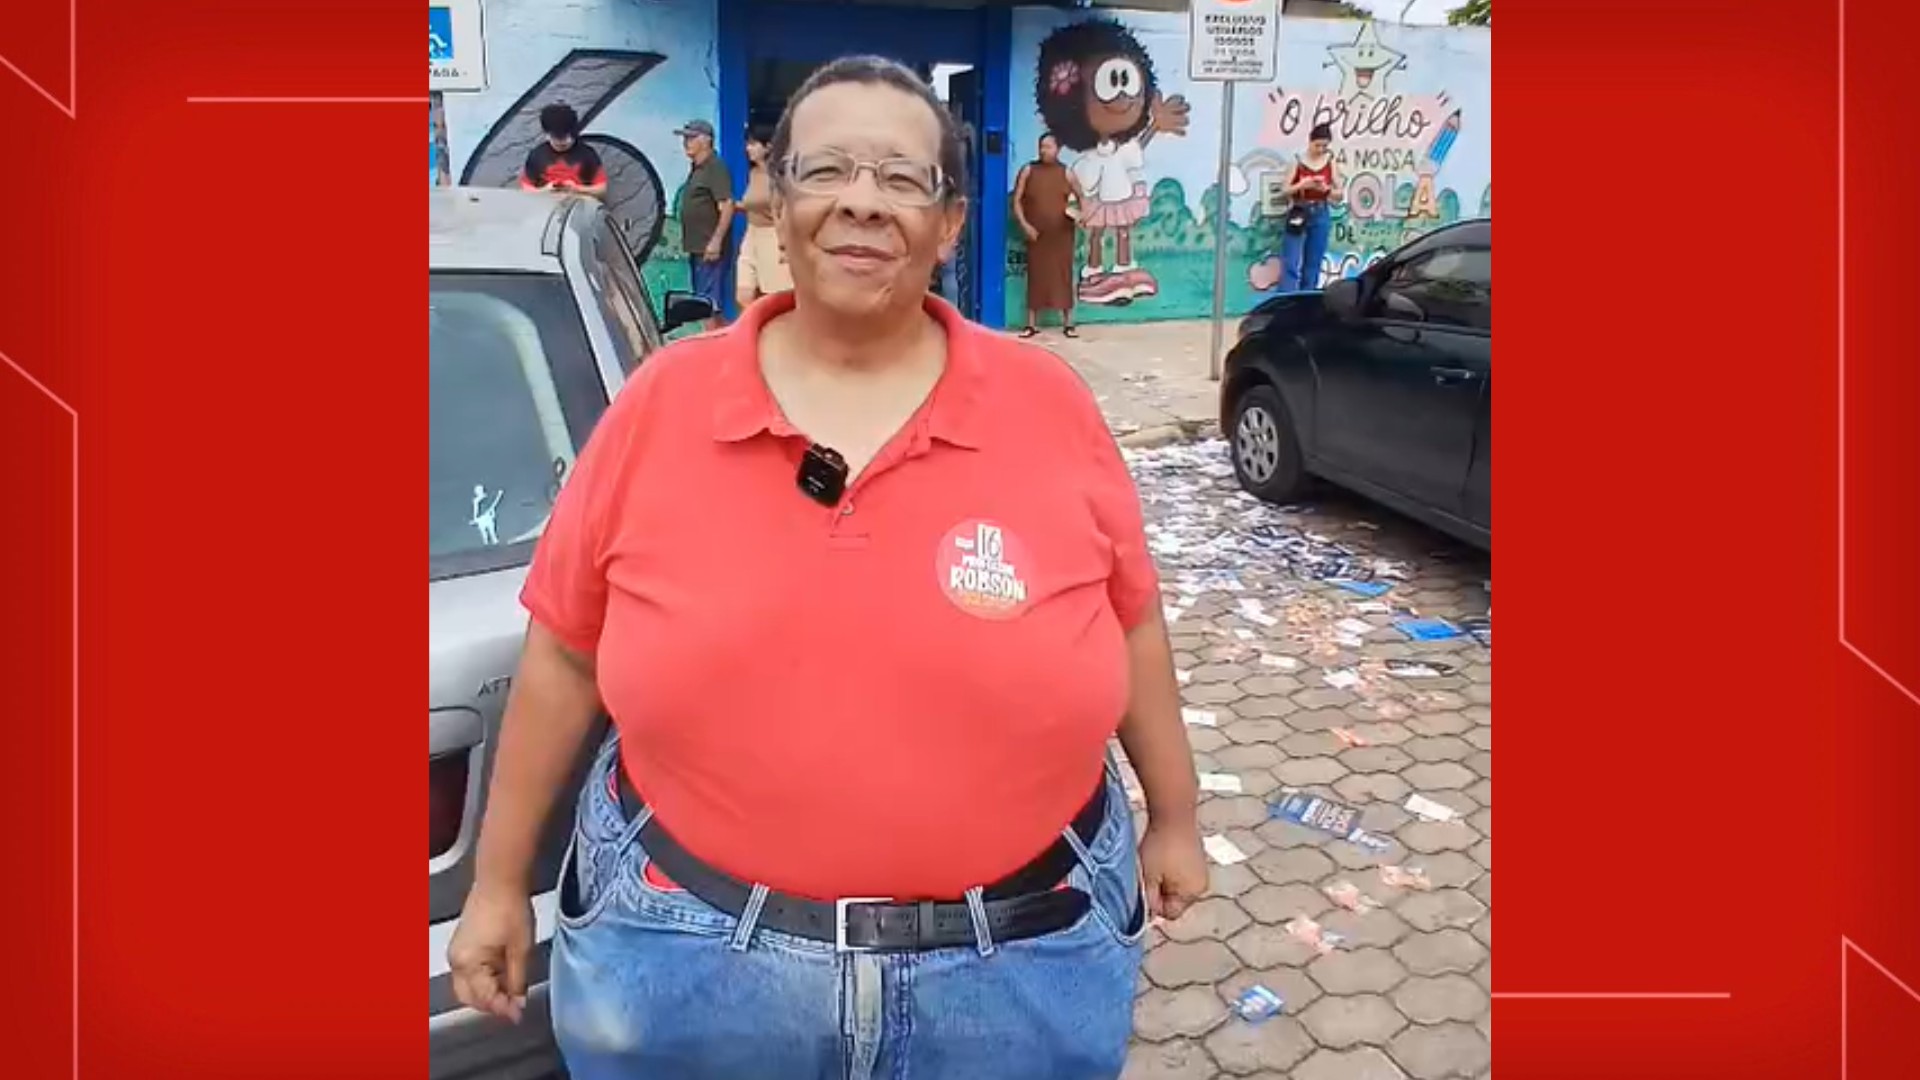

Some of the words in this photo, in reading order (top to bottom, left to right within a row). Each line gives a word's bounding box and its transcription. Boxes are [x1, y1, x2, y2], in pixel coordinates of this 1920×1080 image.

[1354, 148, 1414, 171] NOSSA
[1260, 170, 1440, 219] EOLA
[981, 526, 1001, 558] 16
[950, 565, 1028, 602] ROBSON
